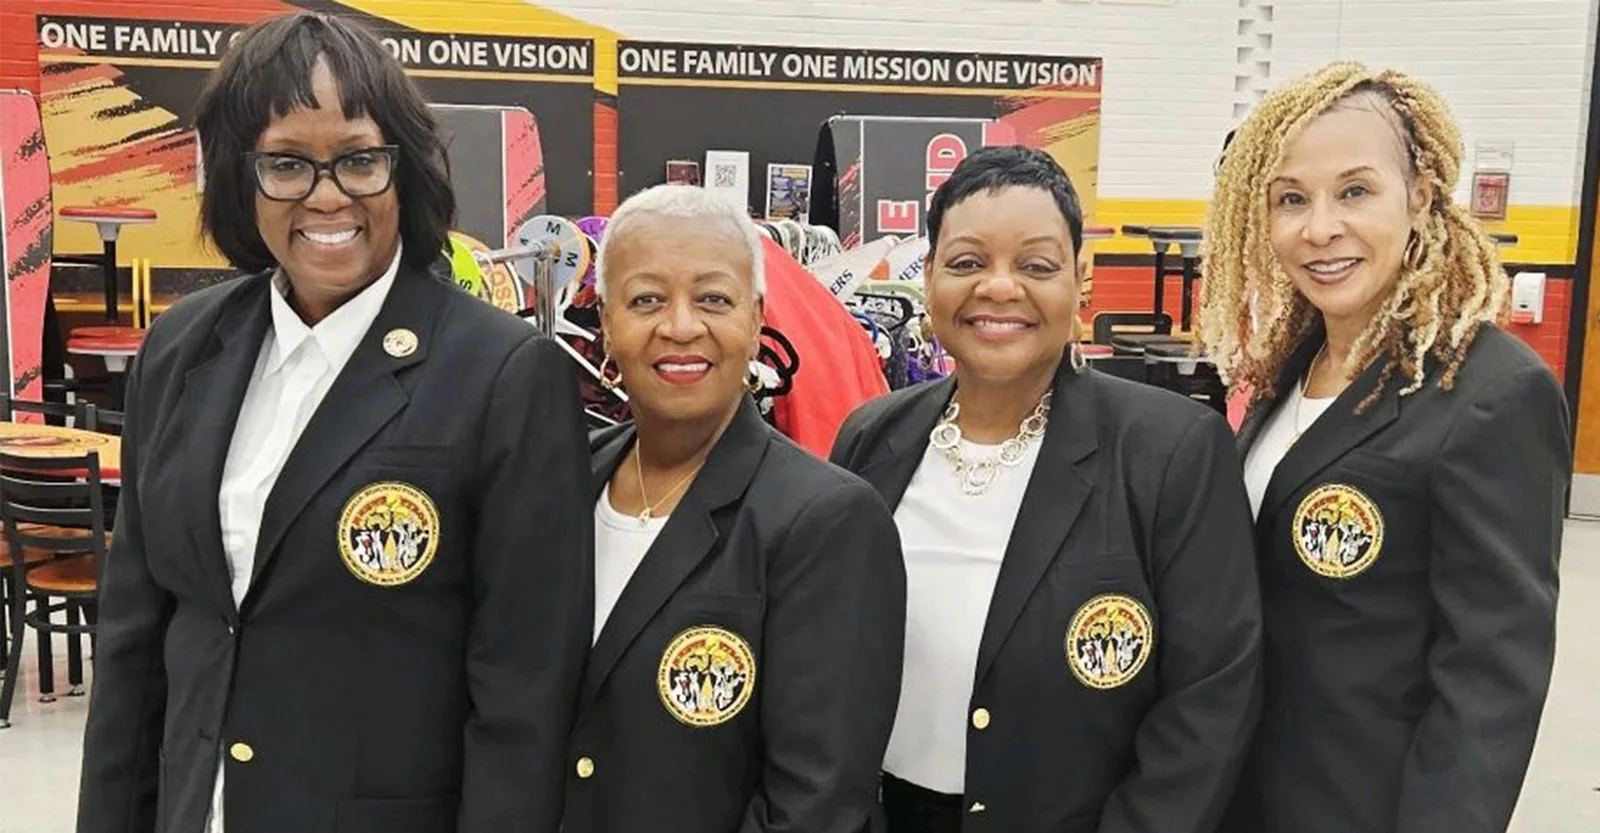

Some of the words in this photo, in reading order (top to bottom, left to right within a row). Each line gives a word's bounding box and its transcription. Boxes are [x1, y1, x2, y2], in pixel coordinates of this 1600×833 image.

[41, 22, 106, 50] ONE
[114, 26, 222, 55] FAMILY
[428, 39, 488, 66] ONE
[492, 42, 587, 70] VISION
[620, 48, 677, 73] ONE
[683, 50, 777, 76] FAMILY
[783, 53, 837, 78] ONE
[843, 56, 950, 82] MISSION
[955, 60, 1009, 84] ONE
[1012, 62, 1097, 88] VISION
[546, 222, 561, 235] M
